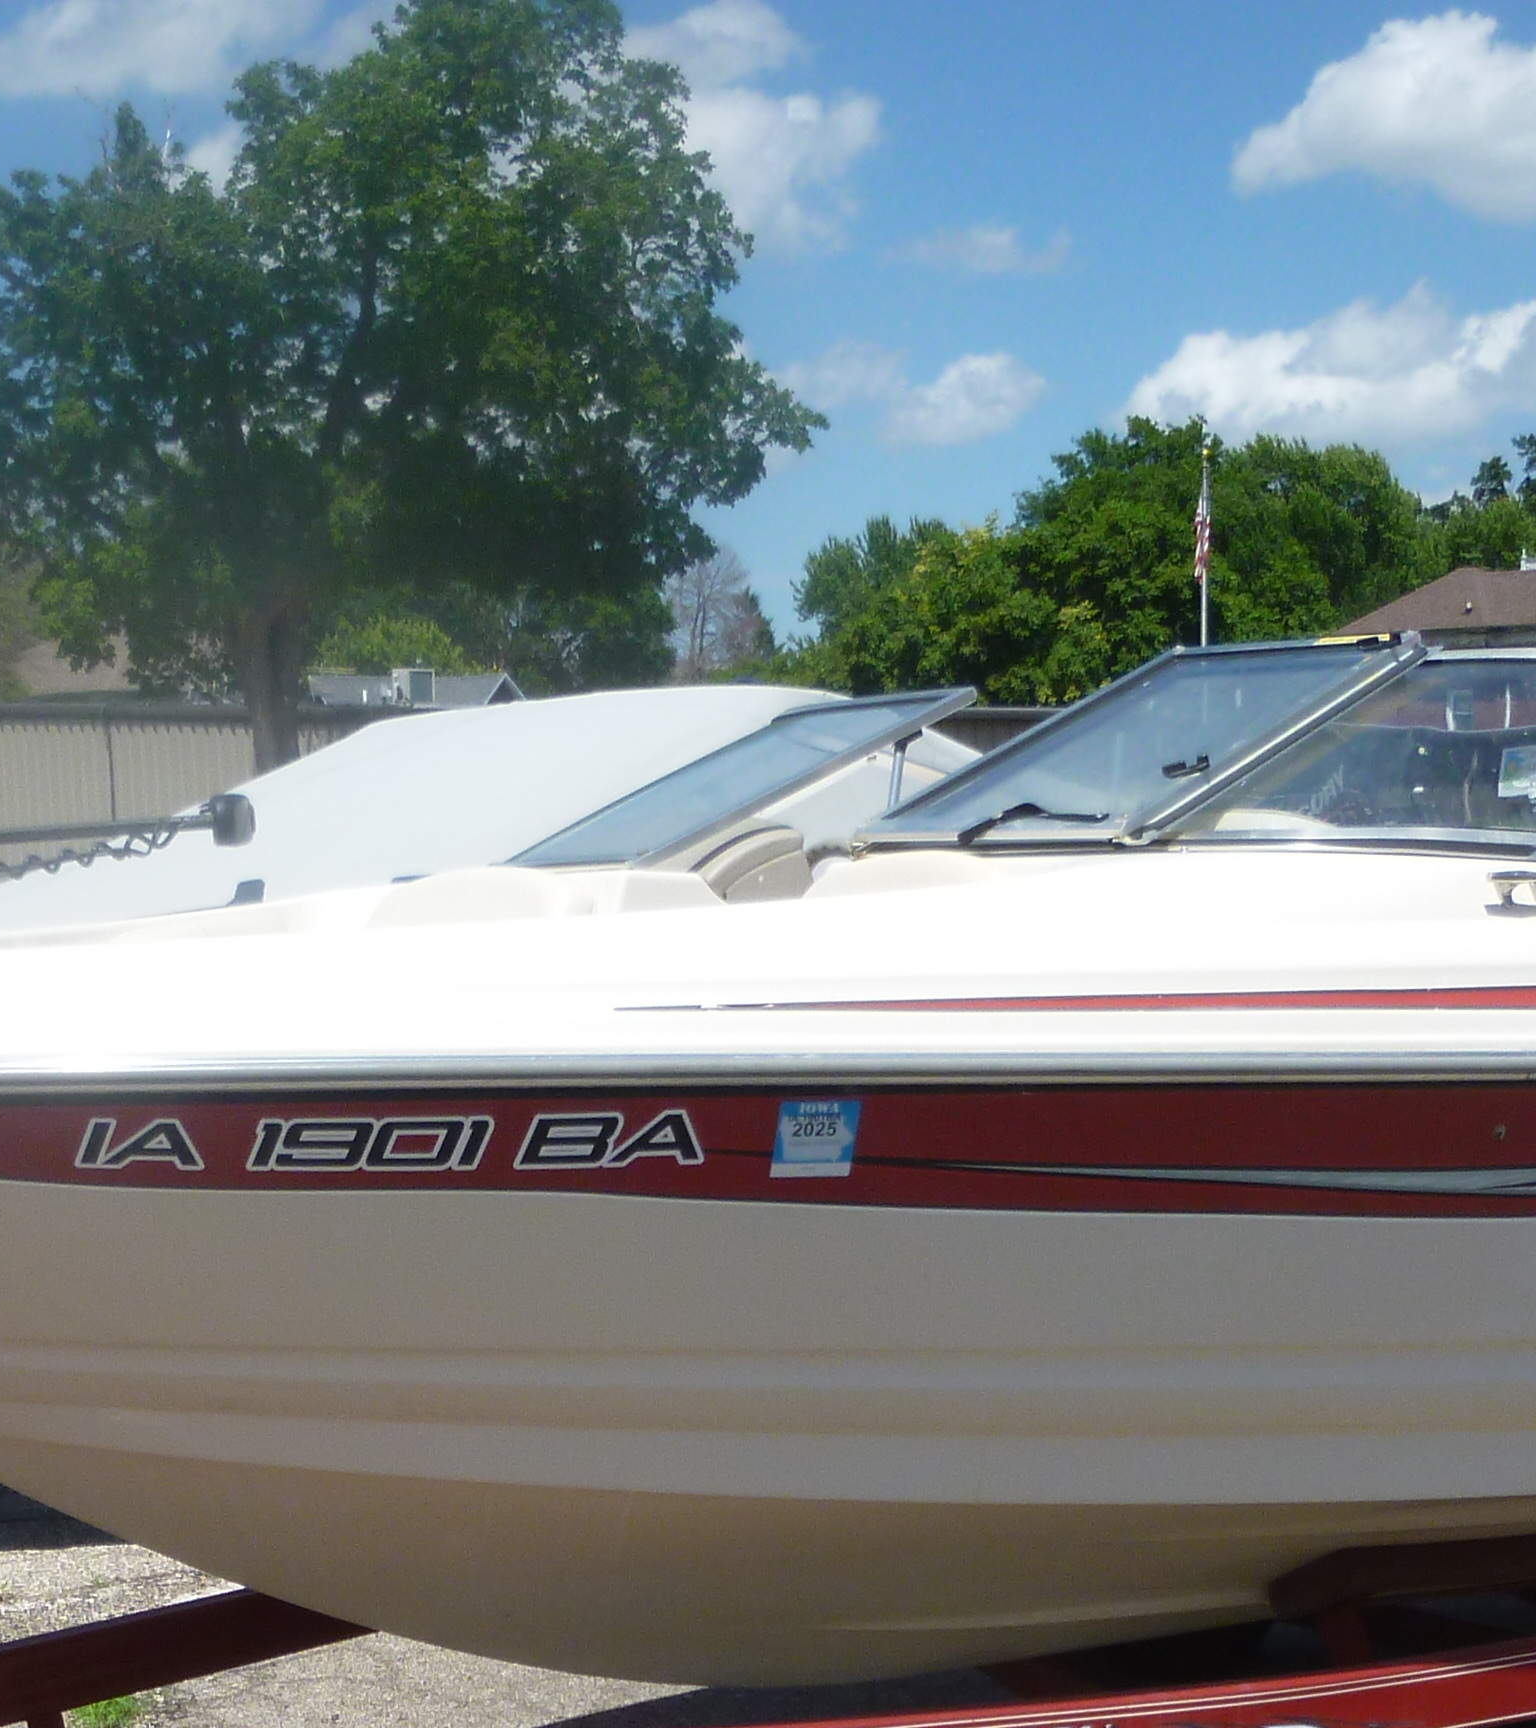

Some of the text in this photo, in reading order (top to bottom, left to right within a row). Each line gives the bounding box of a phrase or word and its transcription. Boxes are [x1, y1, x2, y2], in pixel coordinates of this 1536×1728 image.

[75, 1109, 704, 1171] IA 1901 BA
[791, 1122, 837, 1137] 2025
